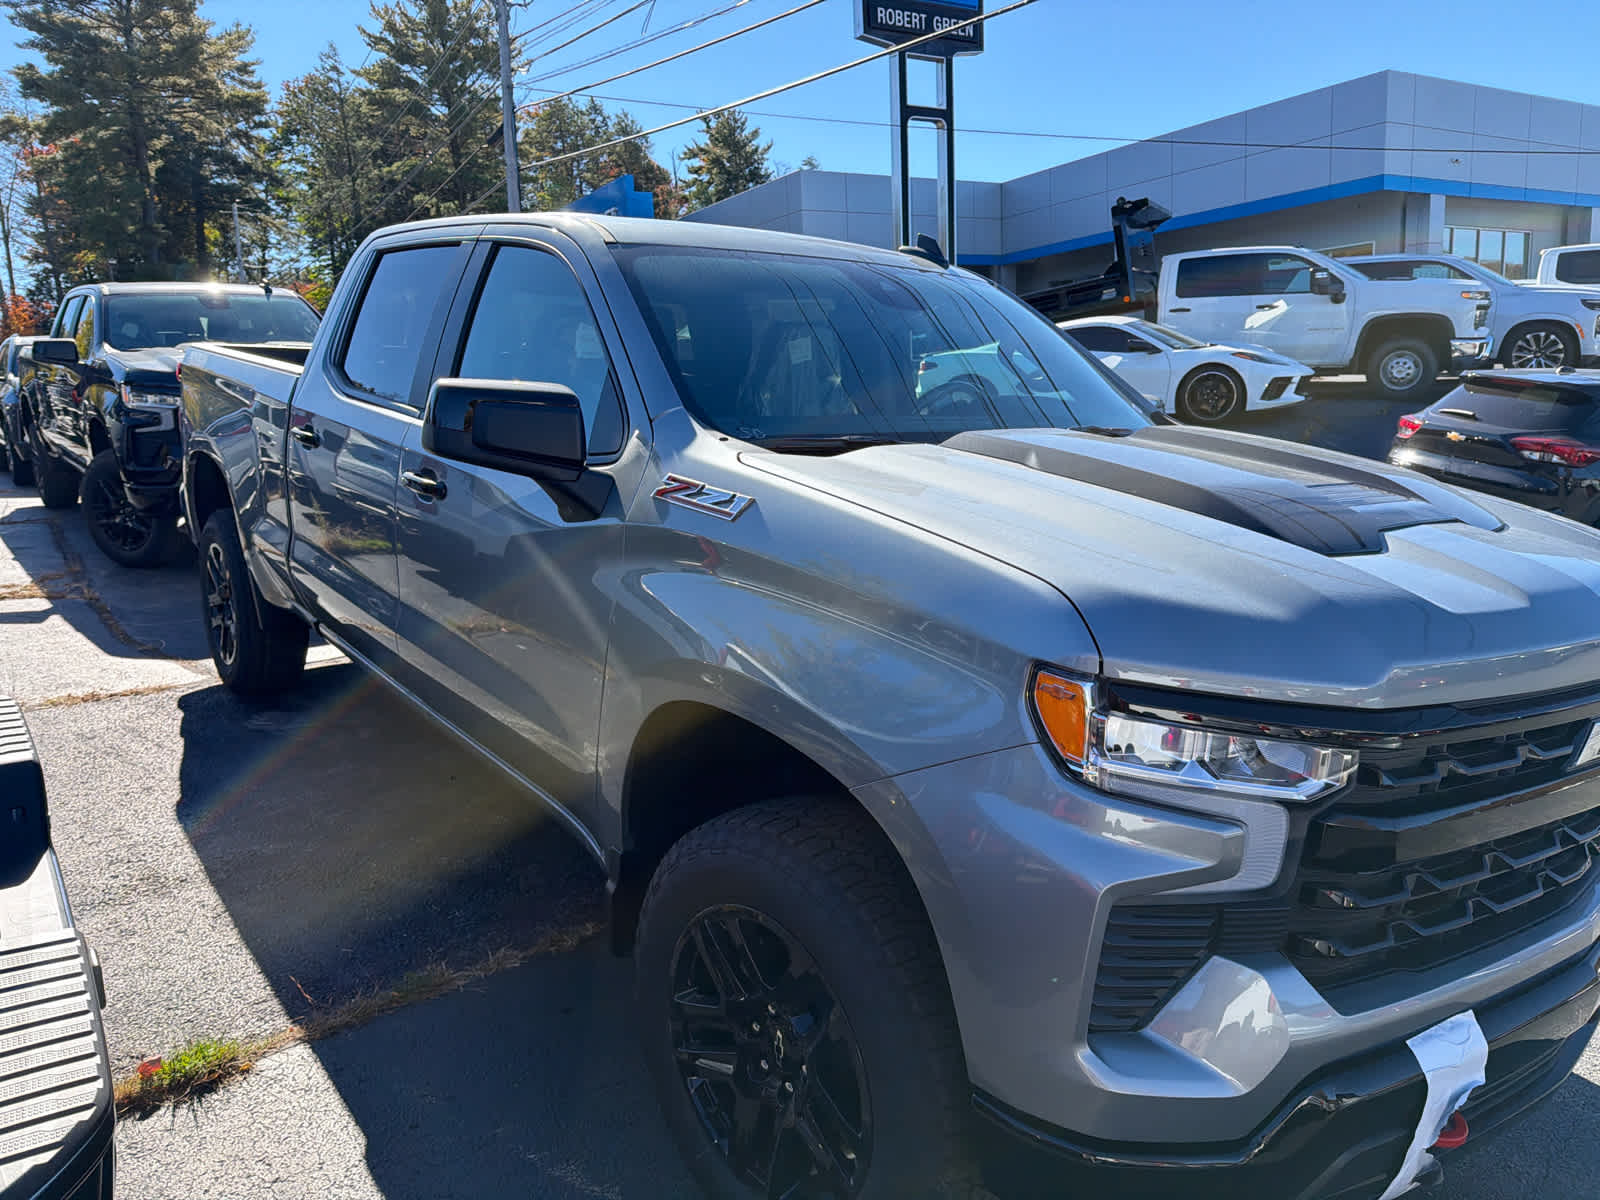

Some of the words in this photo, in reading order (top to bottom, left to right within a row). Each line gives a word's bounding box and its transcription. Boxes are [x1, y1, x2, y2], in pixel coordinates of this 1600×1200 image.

[877, 7, 927, 30] ROBERT
[933, 16, 974, 38] GREEN
[650, 472, 755, 521] Z71
